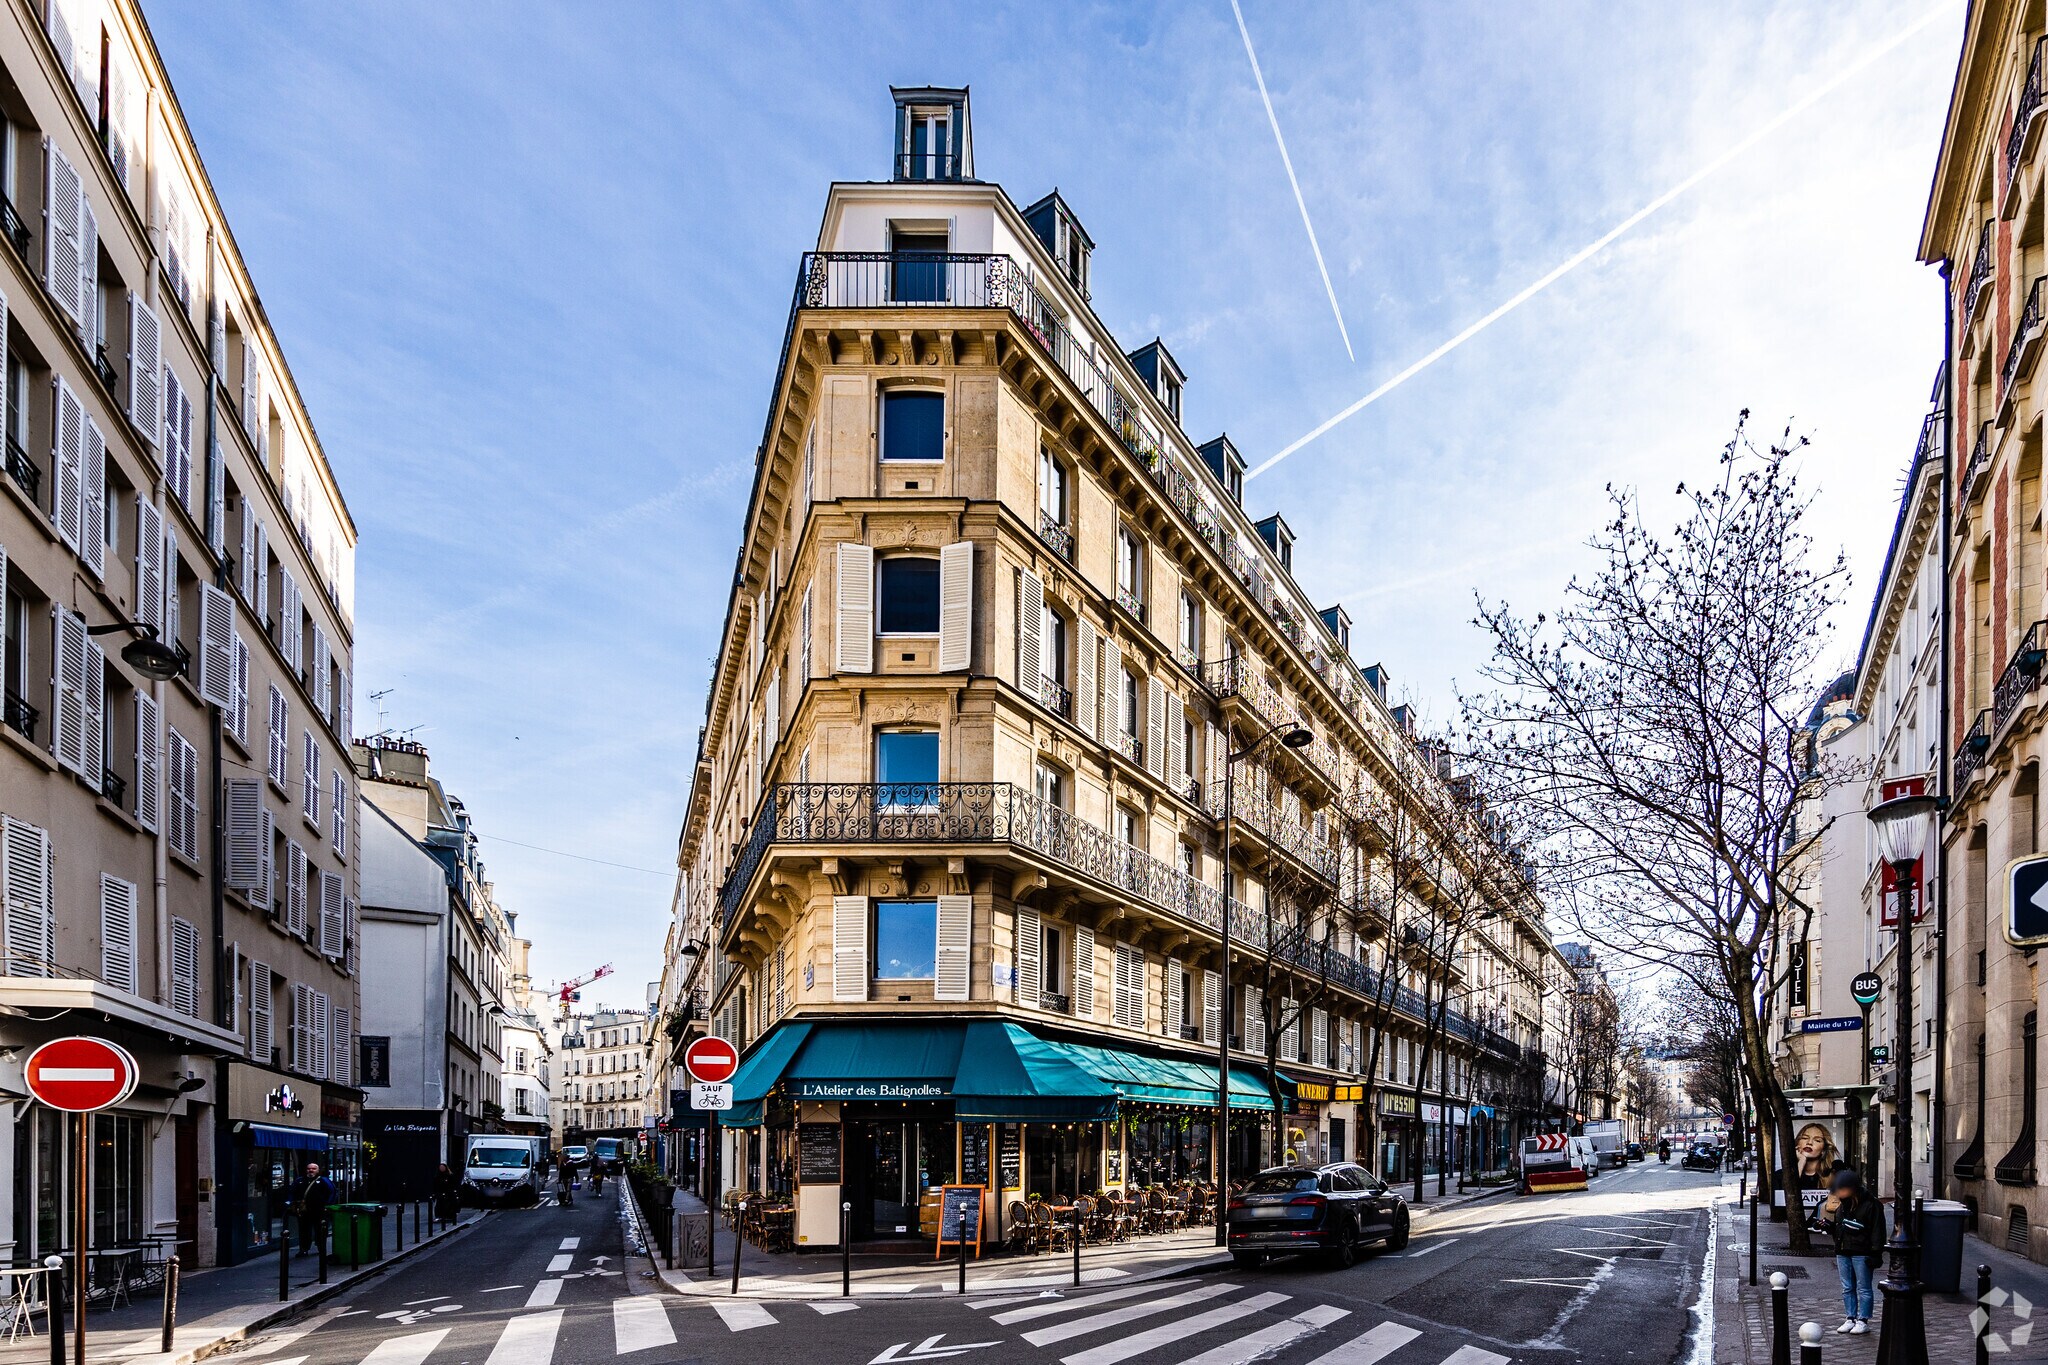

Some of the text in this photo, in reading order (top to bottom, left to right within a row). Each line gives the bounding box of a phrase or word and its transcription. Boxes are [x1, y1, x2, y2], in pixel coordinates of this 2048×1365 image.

[1855, 979, 1878, 991] BUS
[1807, 1022, 1831, 1030] Mairie
[1832, 1021, 1842, 1029] du
[1874, 1048, 1886, 1056] 66
[802, 1084, 941, 1098] L'Atelier des Batignolles
[1384, 1092, 1415, 1114] pressin
